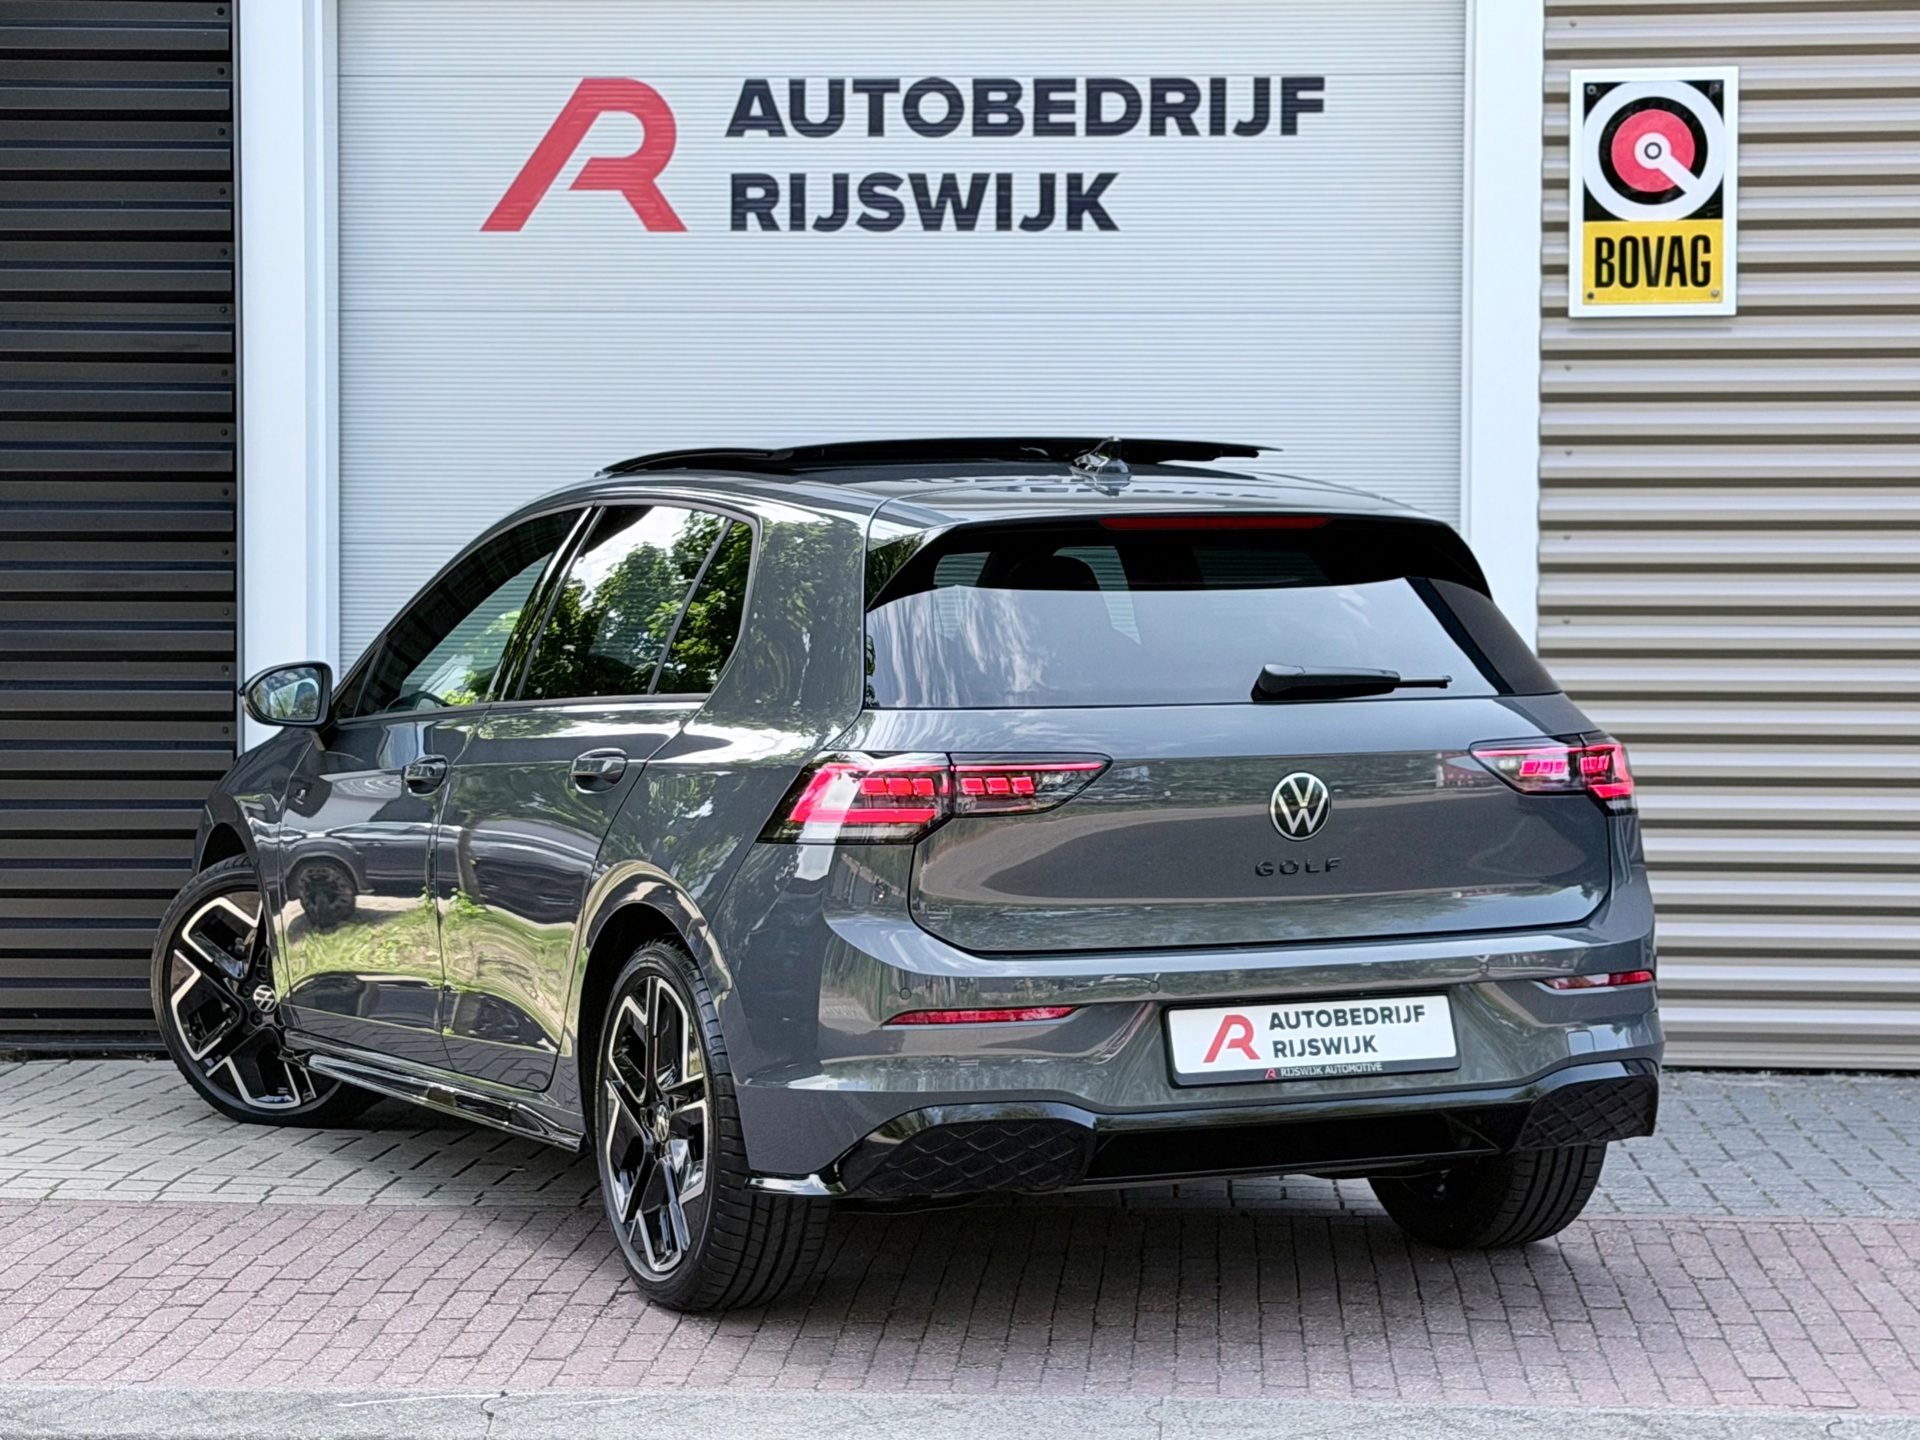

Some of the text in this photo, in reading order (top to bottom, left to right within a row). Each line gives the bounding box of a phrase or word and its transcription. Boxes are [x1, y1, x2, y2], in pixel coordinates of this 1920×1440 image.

[725, 76, 1326, 138] AUTOBEDRIJF
[730, 172, 1120, 232] RIJSWIJK
[1594, 234, 1712, 289] BOVAG
[1255, 857, 1341, 877] GOLF
[1269, 1004, 1426, 1031] AUTOBEDRIJF
[1272, 1035, 1379, 1059] RIJSWIJK
[1280, 1066, 1323, 1078] RIJSWIJK
[1324, 1062, 1384, 1075] AUTOMOTIVE
